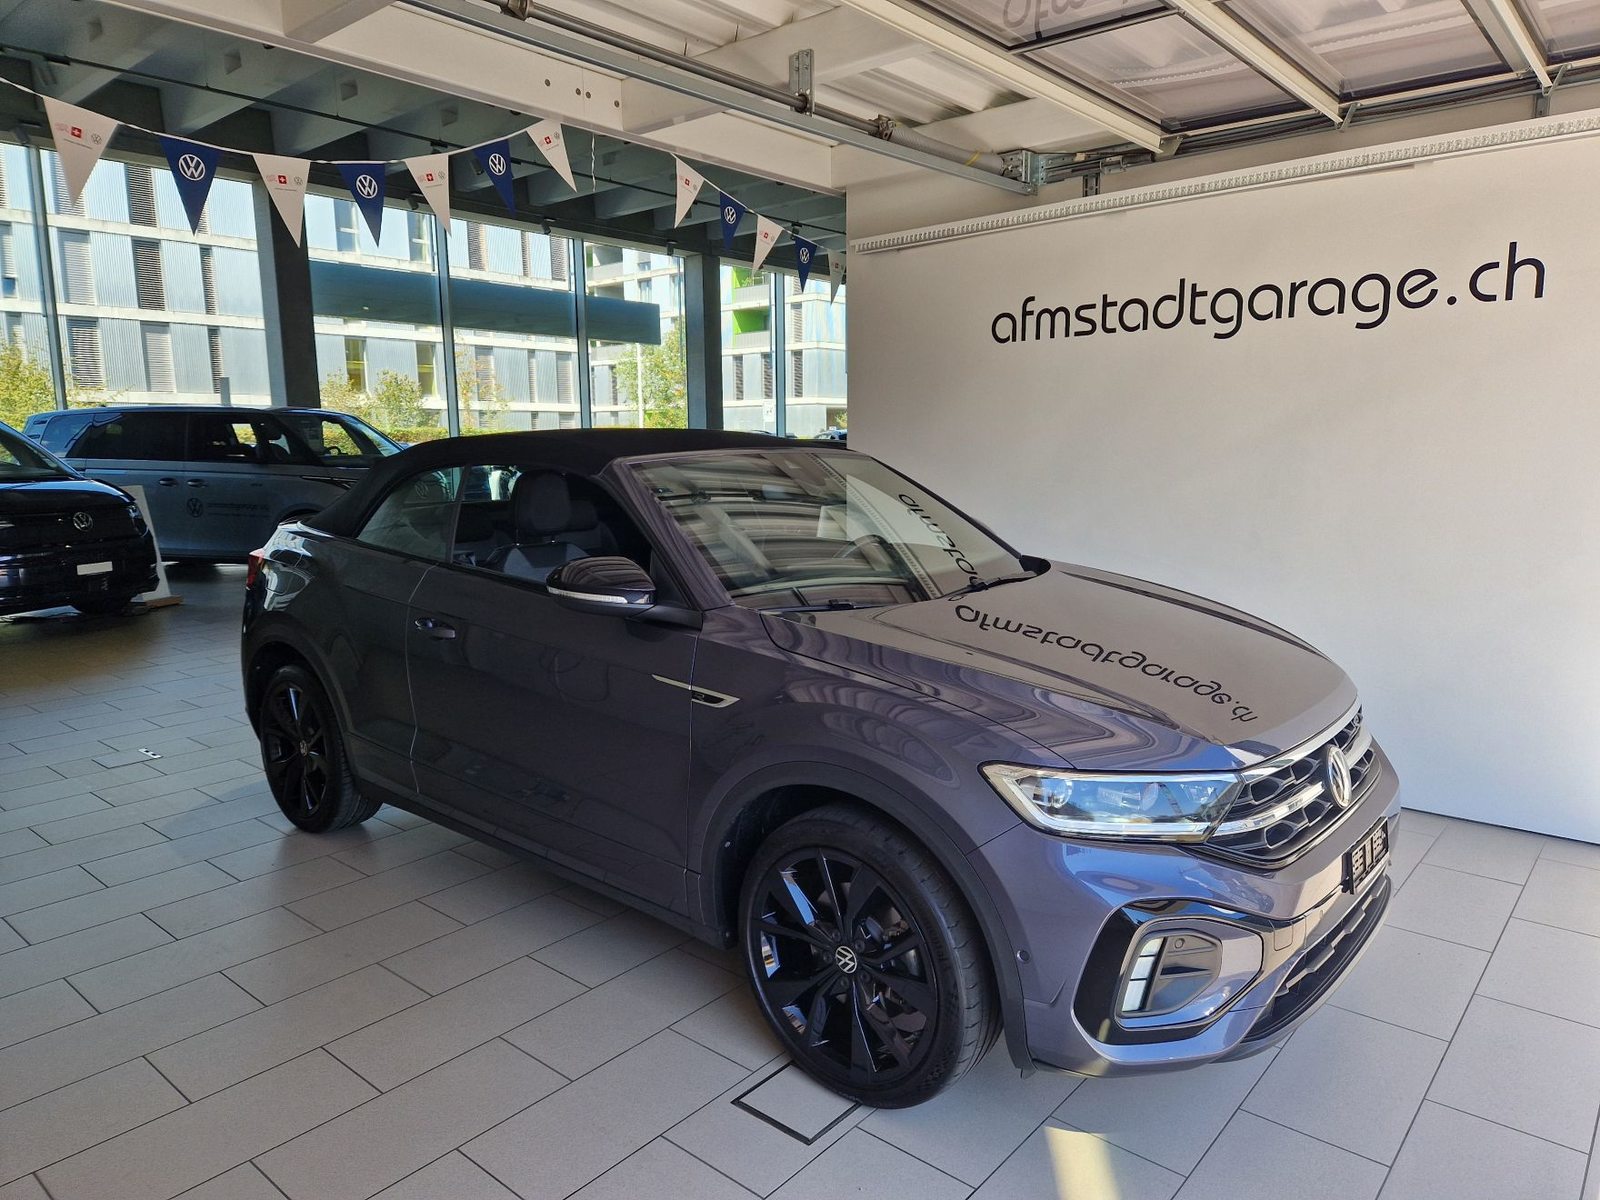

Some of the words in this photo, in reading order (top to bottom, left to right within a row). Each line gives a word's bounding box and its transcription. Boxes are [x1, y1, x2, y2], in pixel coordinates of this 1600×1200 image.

[178, 154, 206, 181] VW
[356, 174, 378, 199] VW
[992, 242, 1546, 344] afmstadtgarage.ch
